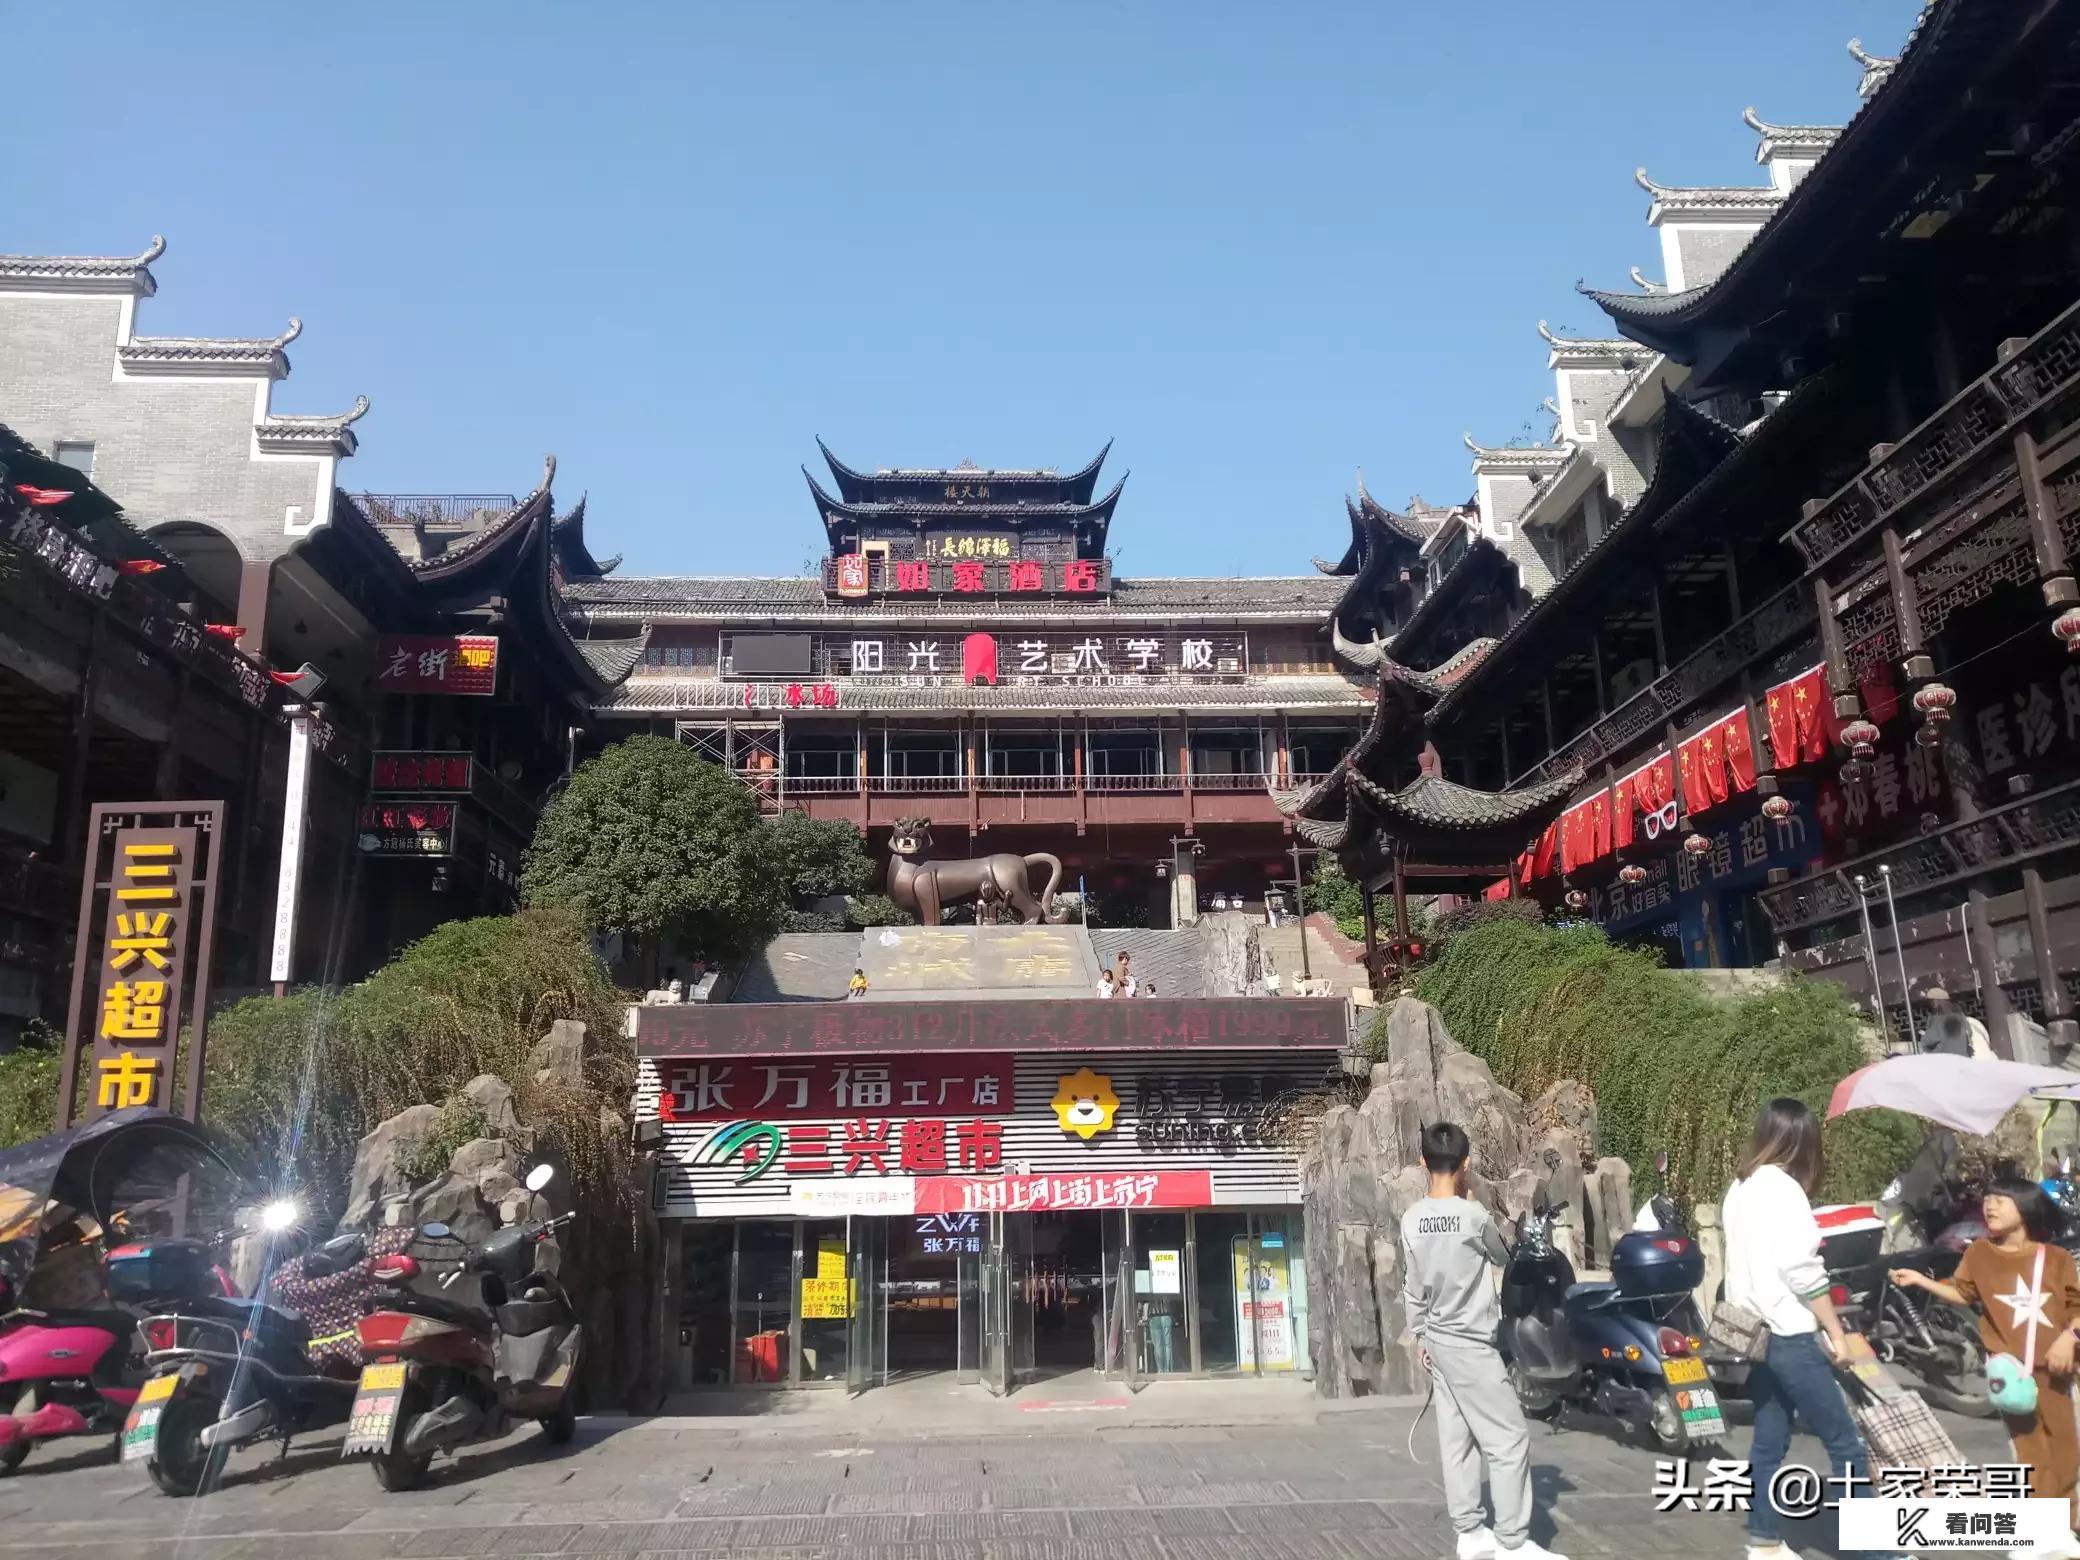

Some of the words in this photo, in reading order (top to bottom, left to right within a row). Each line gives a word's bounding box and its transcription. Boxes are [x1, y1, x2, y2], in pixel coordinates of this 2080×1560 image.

[896, 560, 1098, 593] 如家酒店
[853, 640, 940, 672] 阳光
[1017, 638, 1214, 672] 艺术学校
[97, 844, 178, 1110] 三兴超市
[784, 1117, 1004, 1176] 三兴超市
